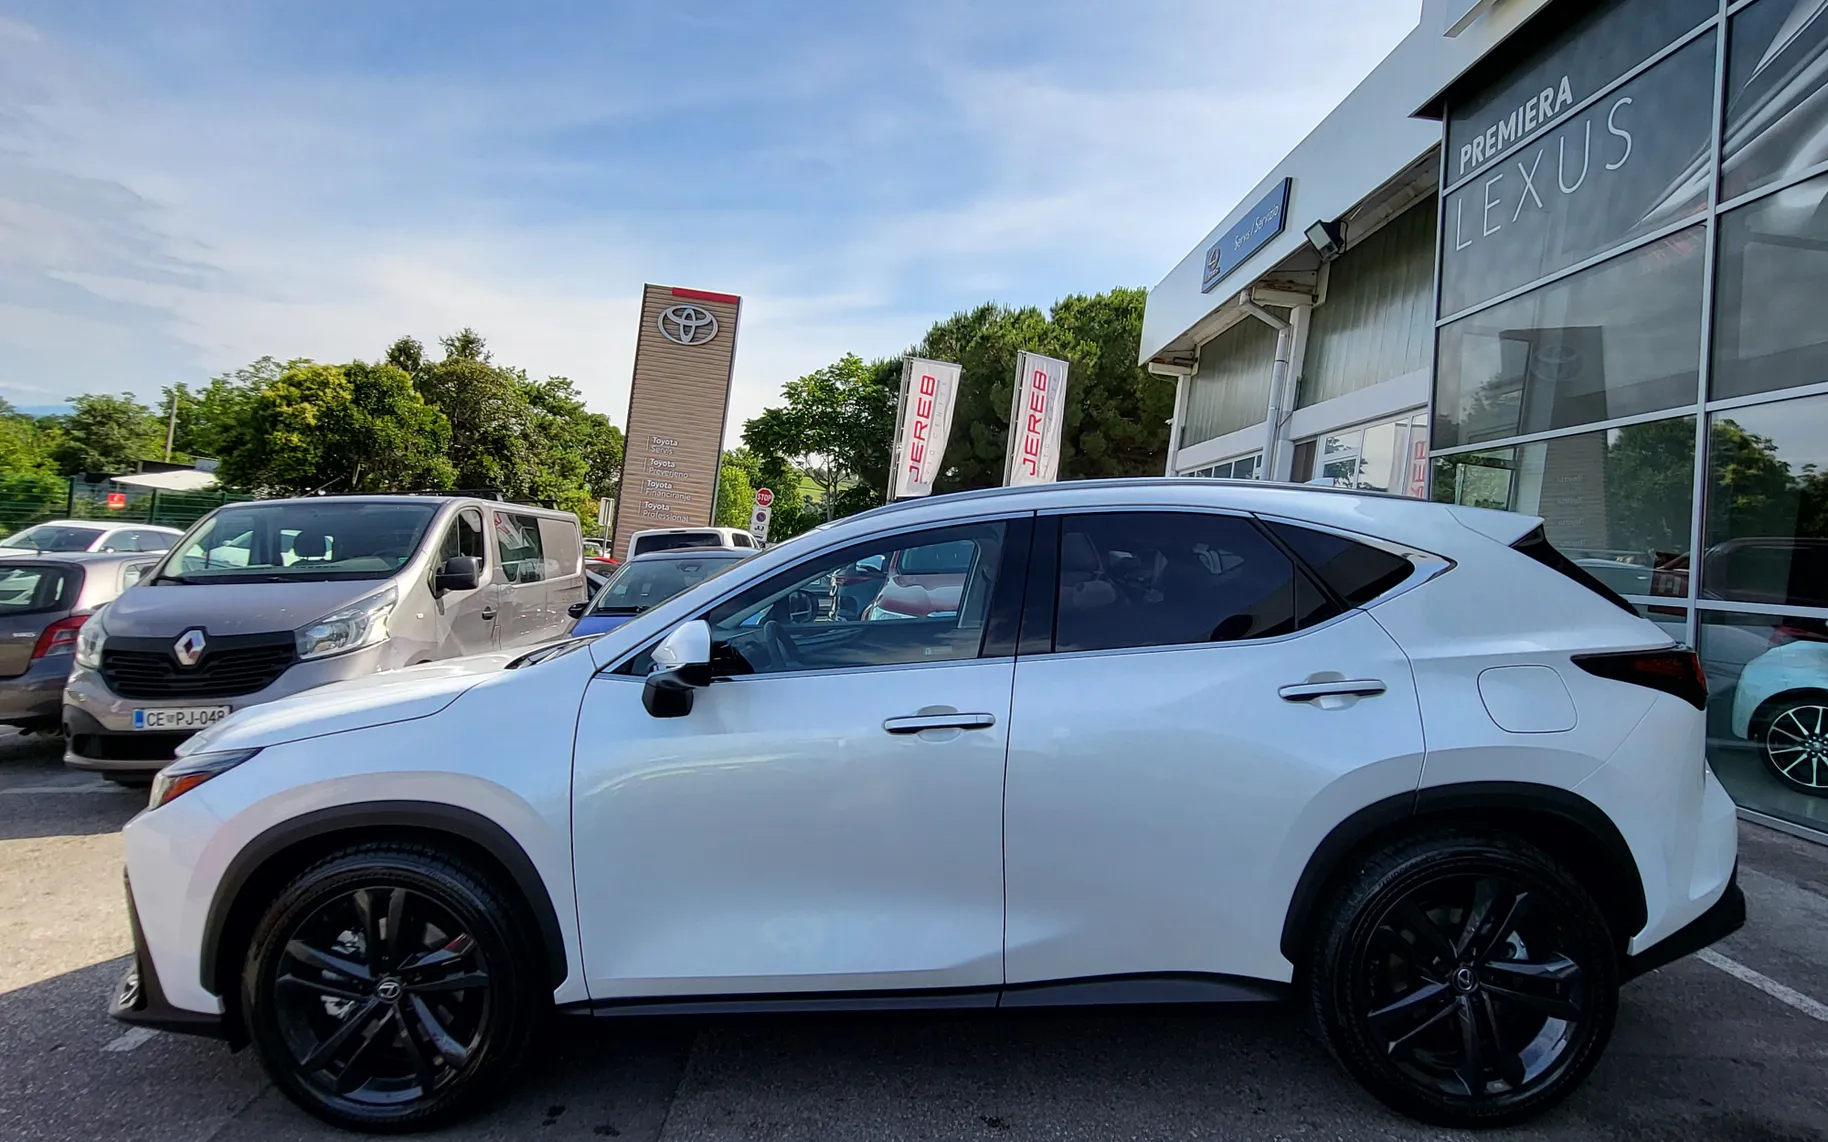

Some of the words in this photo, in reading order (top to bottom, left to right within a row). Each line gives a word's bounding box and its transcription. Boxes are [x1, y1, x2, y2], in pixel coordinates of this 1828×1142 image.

[1459, 75, 1574, 176] PREMIERA
[1456, 97, 1633, 252] LEXUS
[908, 374, 936, 483] JEREB
[1022, 369, 1048, 476] JEREB
[652, 436, 679, 447] Toyota
[651, 445, 674, 455] Servis
[650, 457, 676, 468] Toyota
[647, 479, 673, 490] Toyota
[757, 493, 772, 502] STOP
[644, 501, 670, 511] Toyota
[642, 509, 689, 523] Professional
[146, 712, 165, 727] CE
